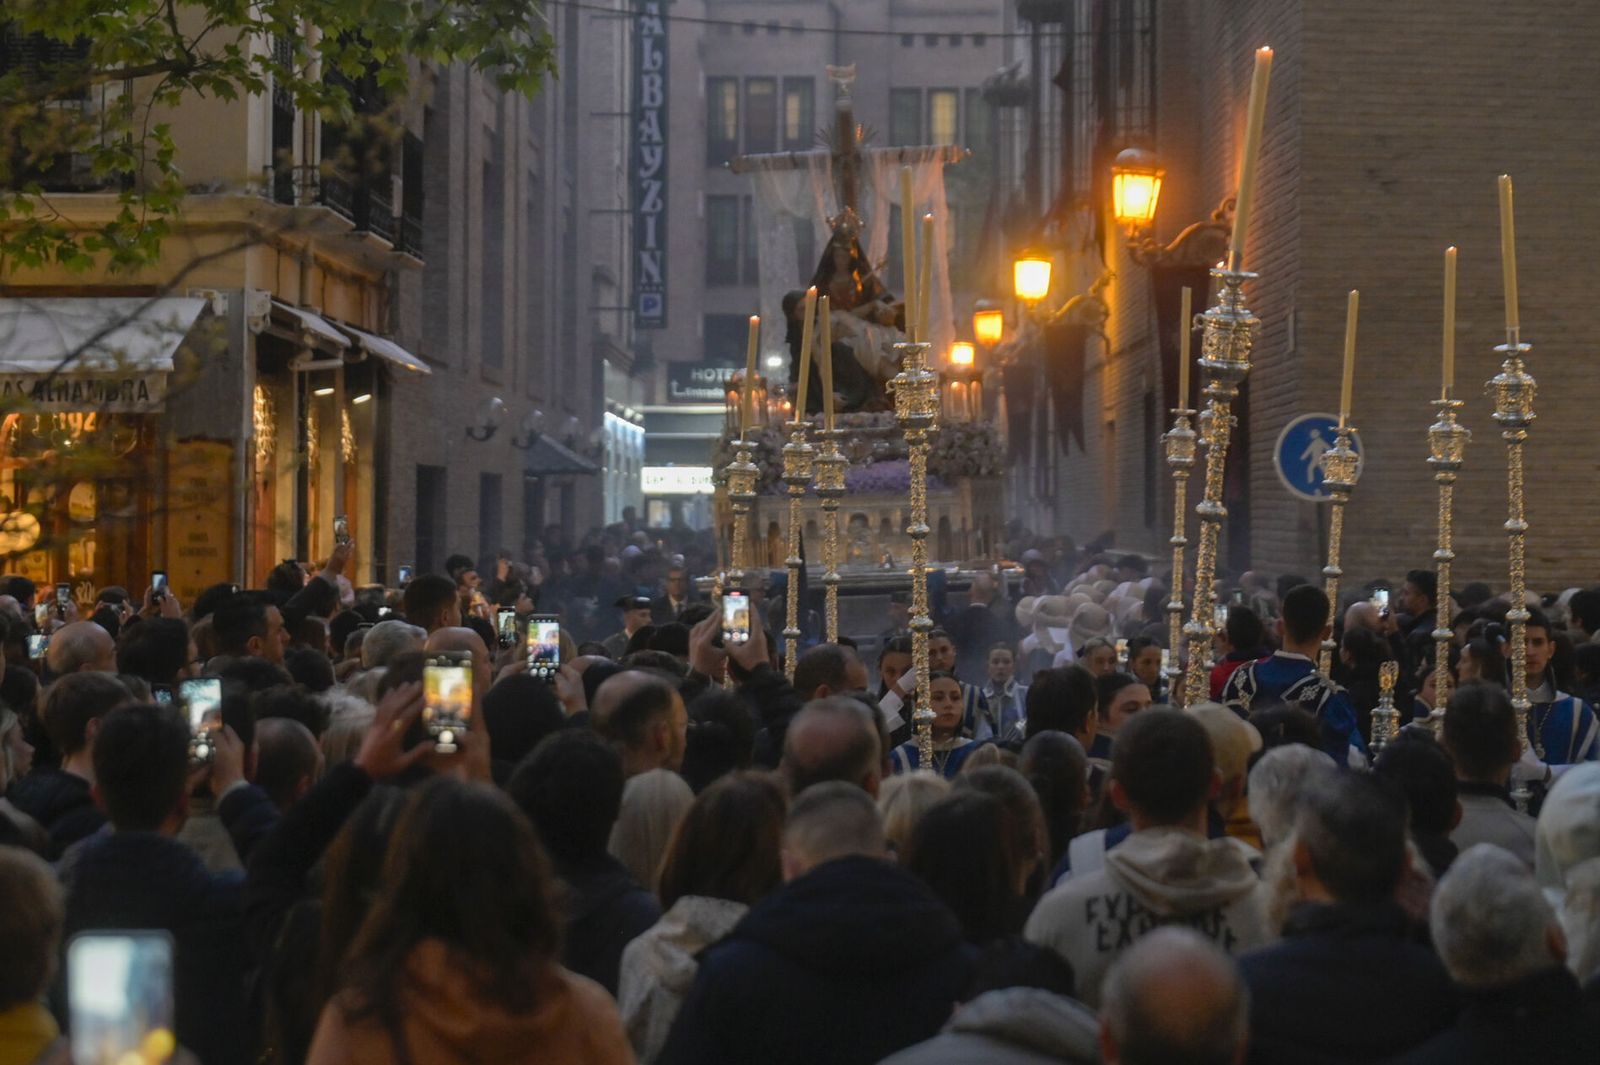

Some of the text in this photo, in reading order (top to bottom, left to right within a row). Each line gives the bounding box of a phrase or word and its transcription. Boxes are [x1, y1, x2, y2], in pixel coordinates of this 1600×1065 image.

[639, 2, 665, 283] ALBAYZIN
[643, 296, 658, 312] P
[690, 367, 737, 382] HOTE
[32, 379, 151, 402] ALHAMBRA
